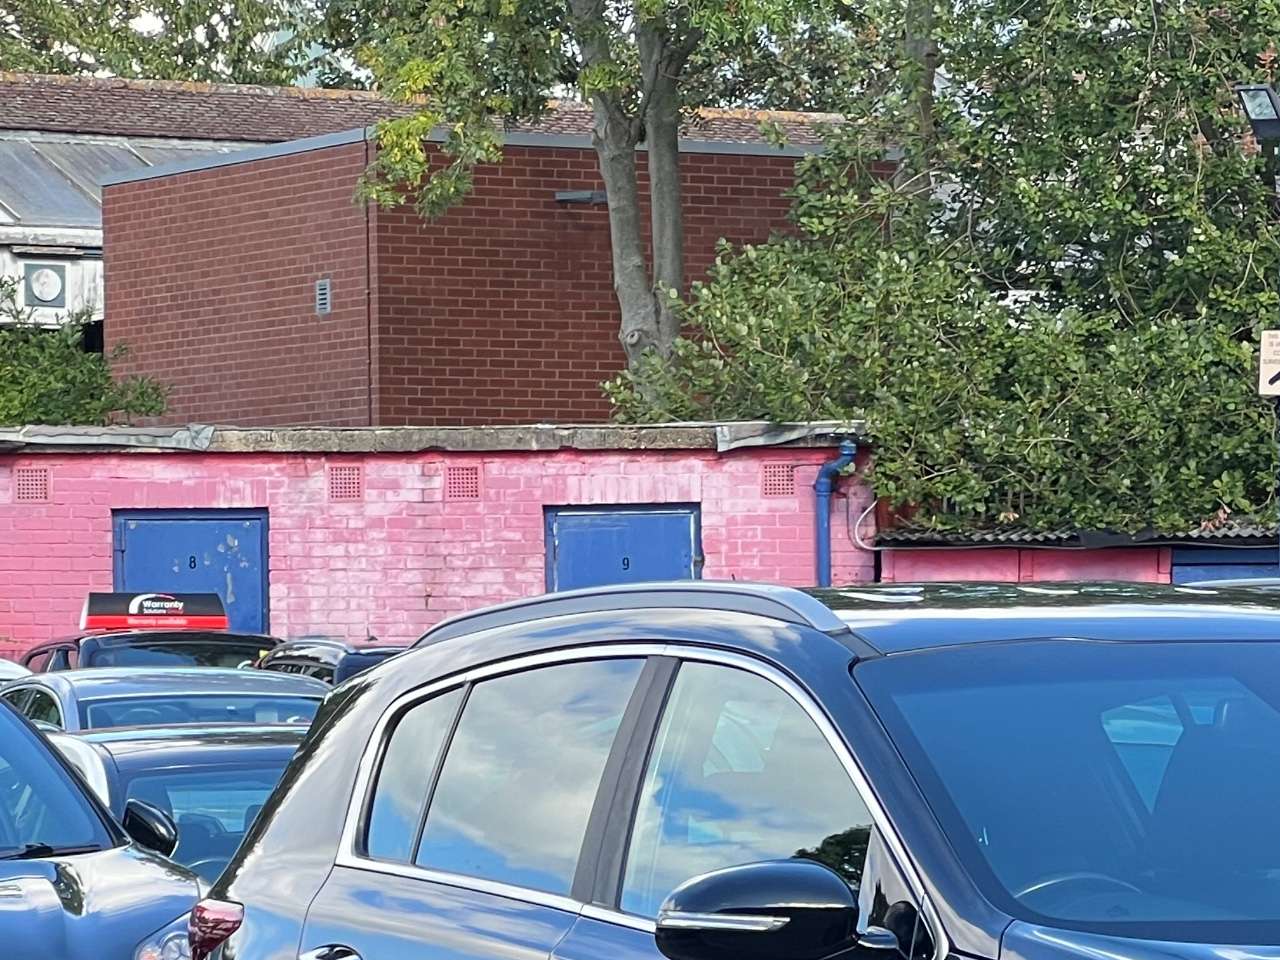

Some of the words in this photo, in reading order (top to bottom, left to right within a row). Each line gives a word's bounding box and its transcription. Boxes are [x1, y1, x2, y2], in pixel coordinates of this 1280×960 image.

[188, 555, 197, 569] 8
[622, 556, 630, 571] 9
[142, 600, 184, 610] Warranty
[127, 618, 157, 626] Warranty
